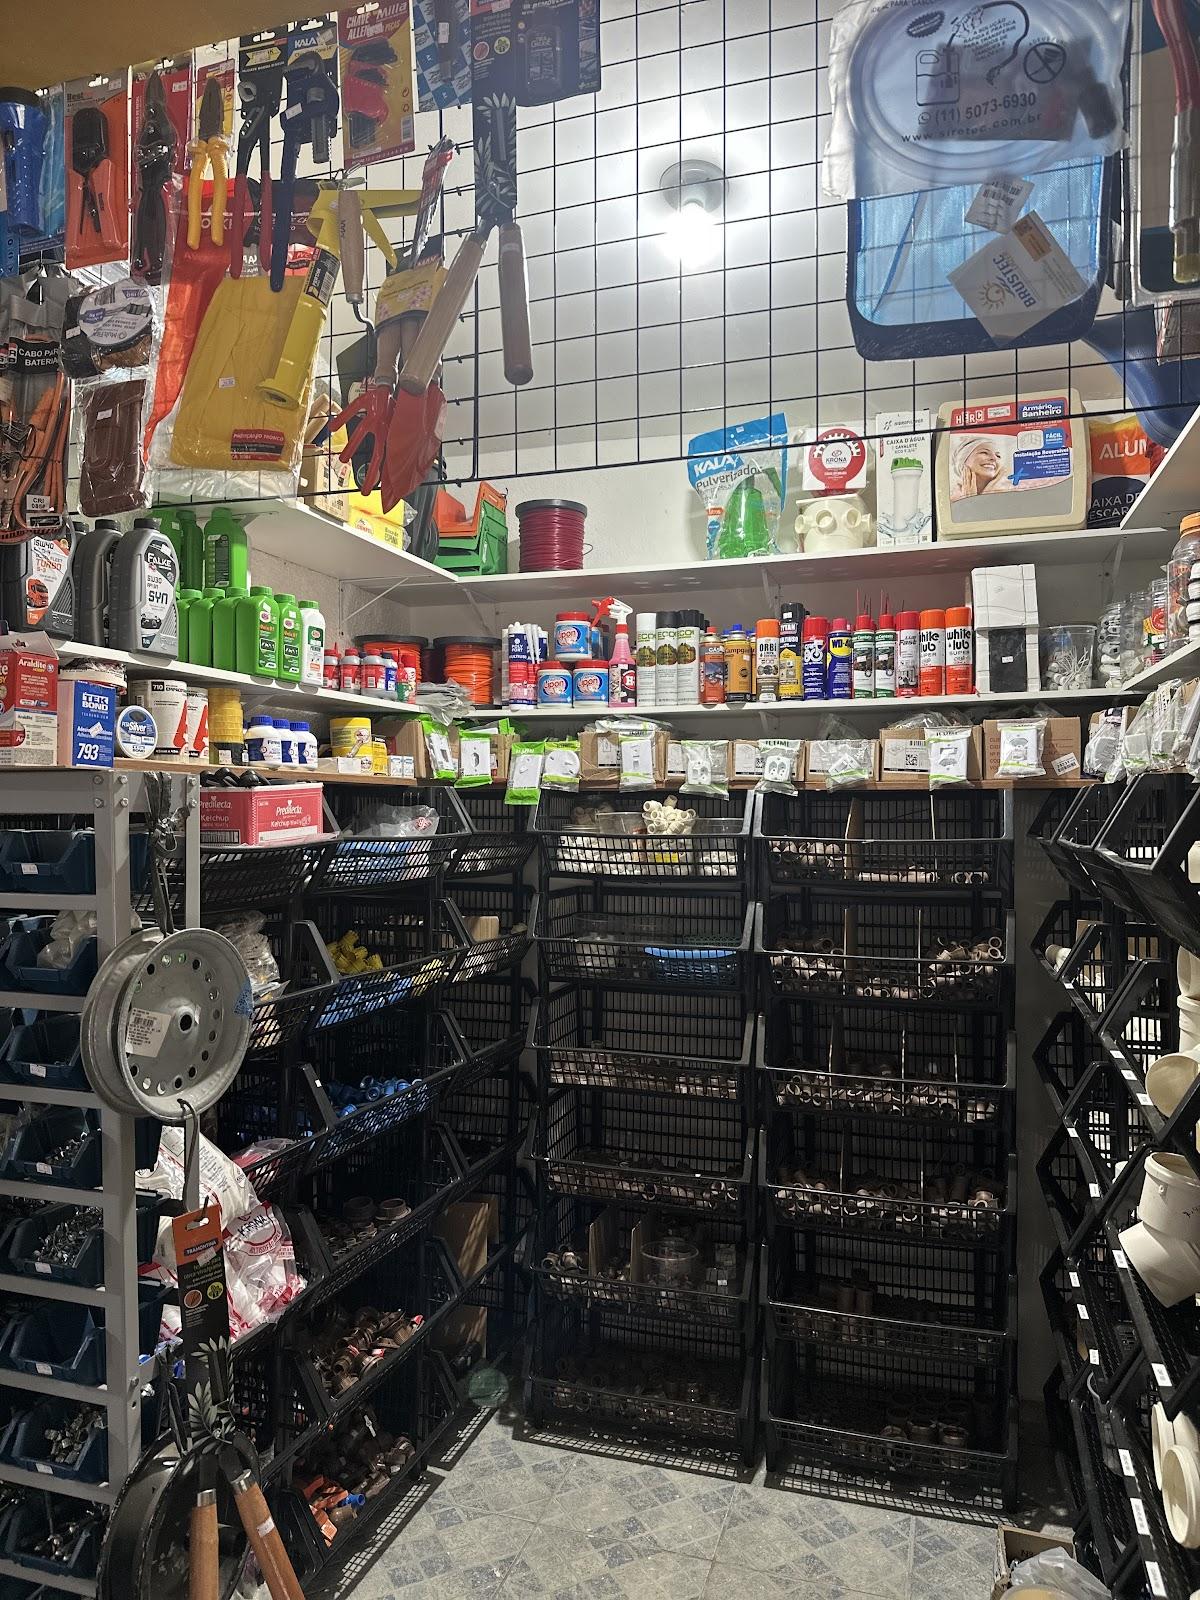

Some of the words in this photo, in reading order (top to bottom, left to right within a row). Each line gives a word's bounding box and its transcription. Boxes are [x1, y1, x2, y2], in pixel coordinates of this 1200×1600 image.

[936, 108, 960, 123] (11)
[965, 92, 1036, 120] 5073-6930
[901, 113, 1042, 142] www.sirotec.com.br
[993, 255, 1036, 307] BRUSTEC
[18, 348, 42, 358] CABO
[25, 357, 58, 366] BATERIA
[1022, 403, 1053, 413] Armário
[1022, 409, 1062, 417] Banheiro
[955, 410, 984, 424] HERC
[694, 453, 734, 477] KALA
[697, 465, 763, 490] Pulverizador
[1090, 496, 1122, 508] AIXA
[147, 553, 172, 567] FALKE
[148, 590, 168, 604] SYN
[920, 631, 940, 642] hite
[947, 629, 971, 640] white
[953, 640, 969, 650] lub
[18, 659, 46, 669] Araldite
[83, 694, 108, 704] TEK
[82, 701, 108, 711] BOND
[129, 722, 146, 732] Silver
[77, 743, 99, 760] 793
[276, 804, 302, 816] Predilecta
[271, 819, 290, 828] Ketchup
[186, 1240, 217, 1255] TRAMONTINA
